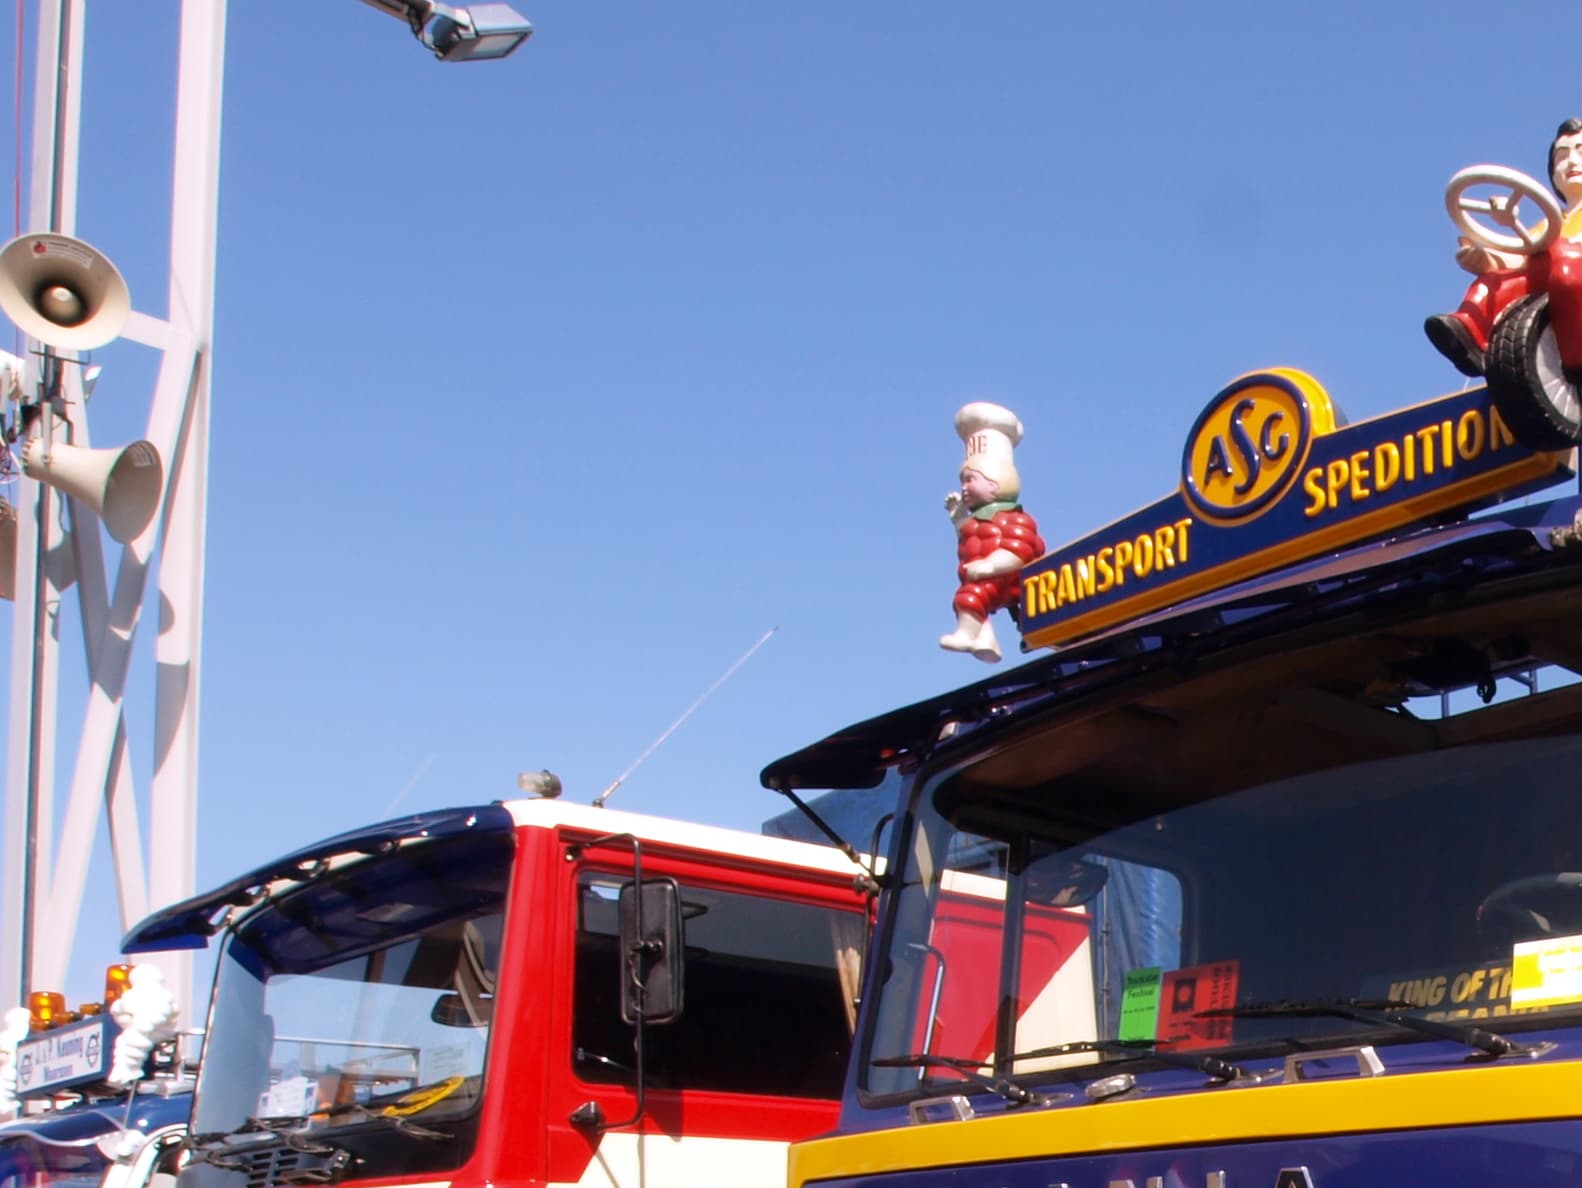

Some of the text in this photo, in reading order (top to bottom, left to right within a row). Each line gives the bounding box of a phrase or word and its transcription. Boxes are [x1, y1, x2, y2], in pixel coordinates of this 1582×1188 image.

[1204, 397, 1289, 496] ASG
[1303, 404, 1515, 517] SPEDITION
[1023, 518, 1193, 618] TRANSPORT
[1388, 975, 1448, 1008] KING
[1452, 969, 1486, 1003] OF
